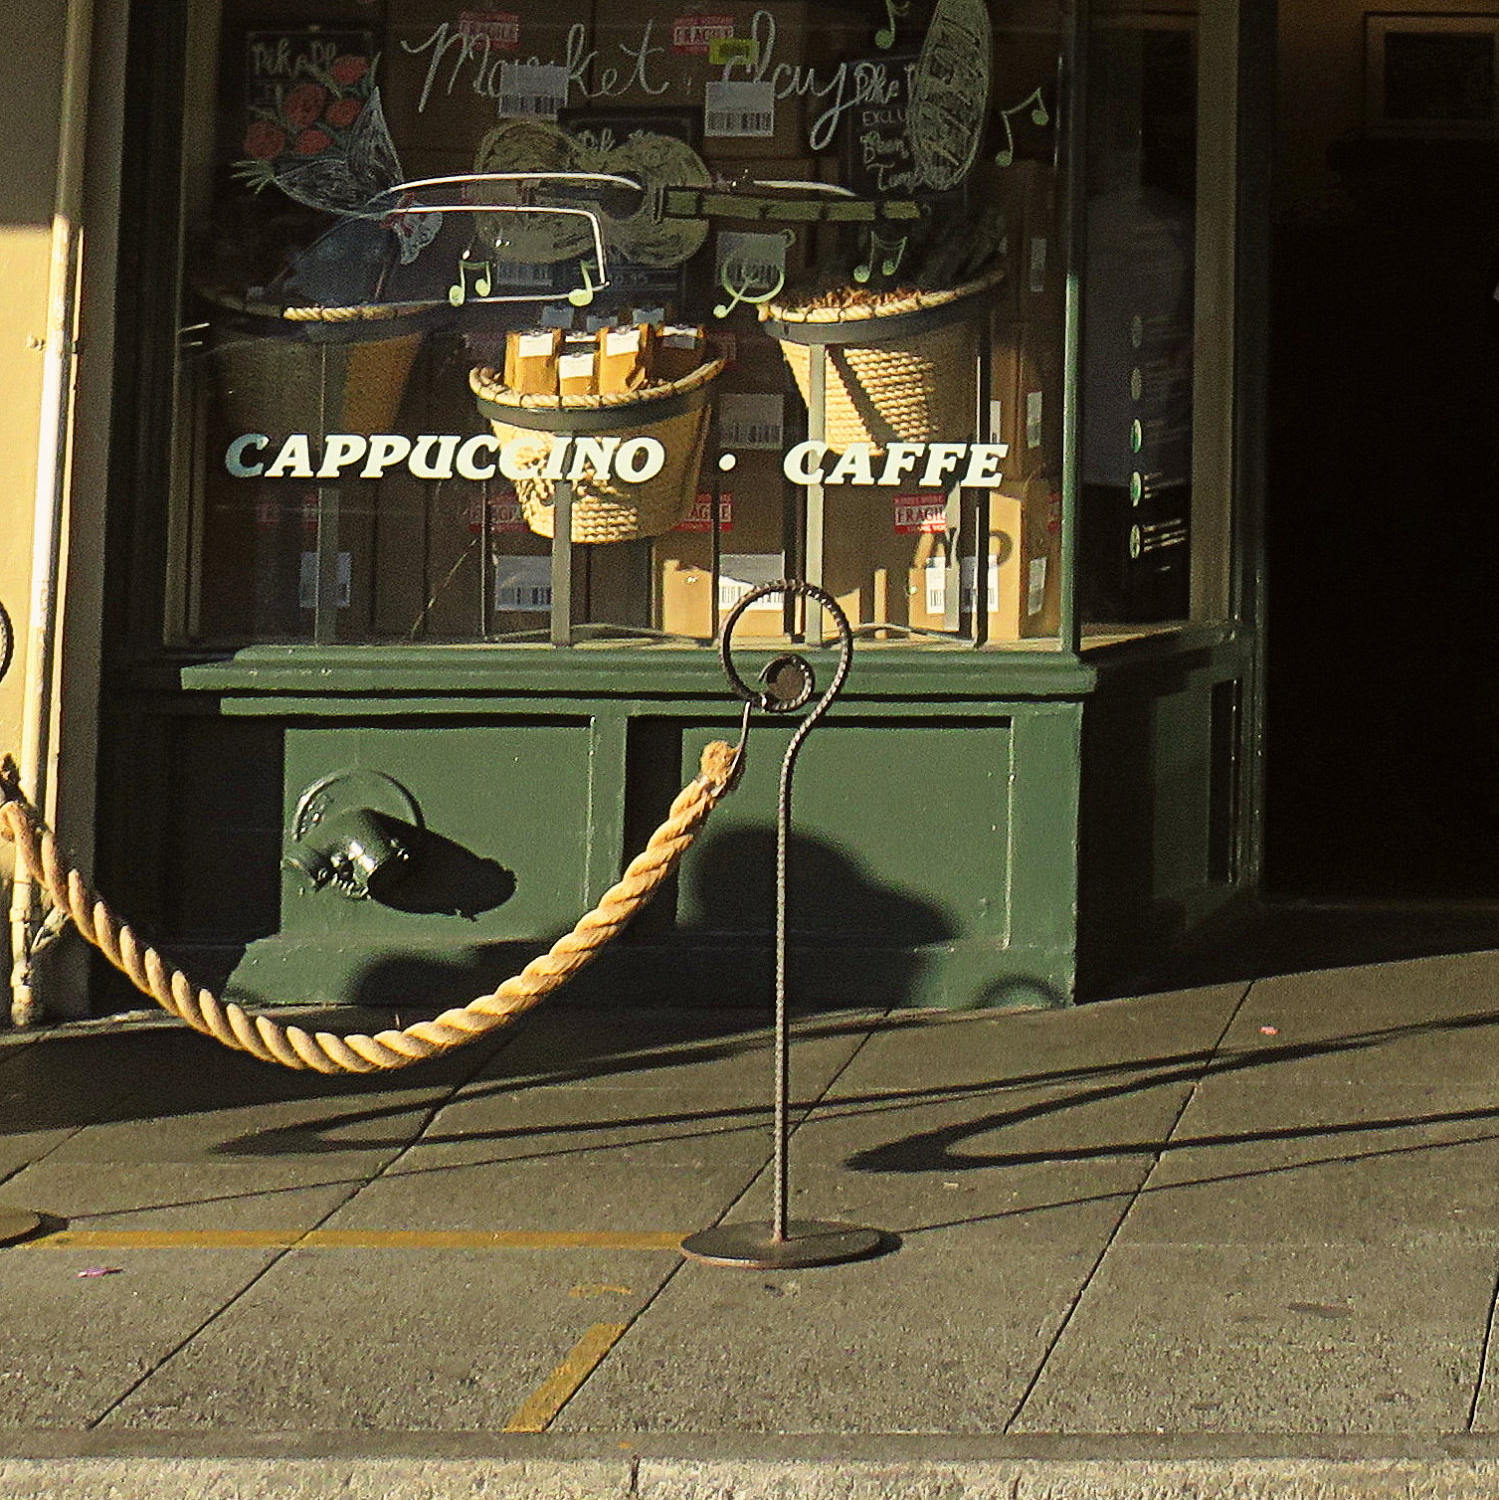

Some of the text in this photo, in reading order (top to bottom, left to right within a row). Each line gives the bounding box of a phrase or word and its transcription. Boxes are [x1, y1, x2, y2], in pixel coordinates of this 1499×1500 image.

[400, 10, 866, 150] Market day
[224, 433, 1009, 488] CAPPUCCINO CAFFE
[897, 505, 947, 522] FRAGIL
